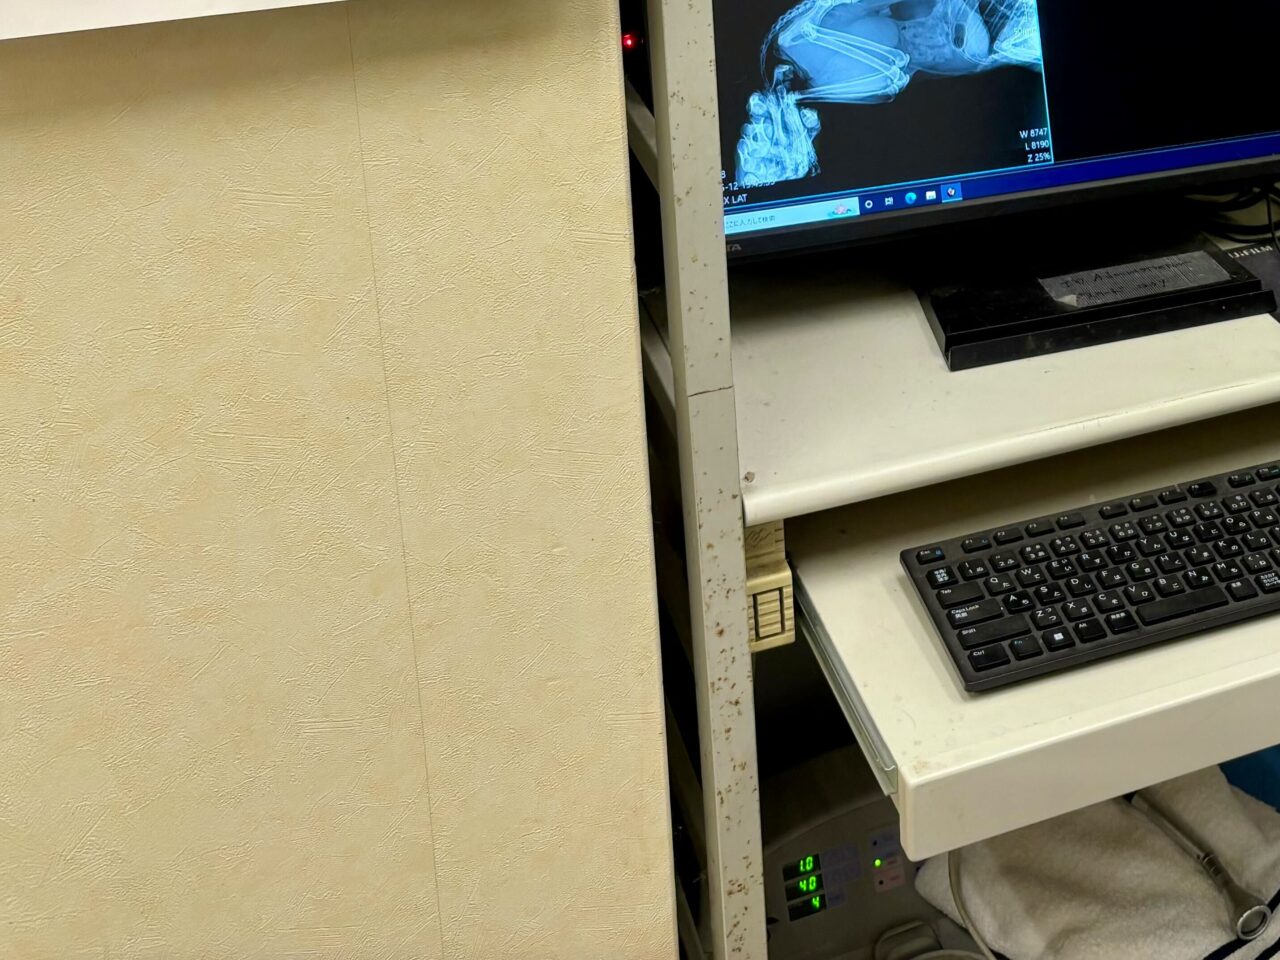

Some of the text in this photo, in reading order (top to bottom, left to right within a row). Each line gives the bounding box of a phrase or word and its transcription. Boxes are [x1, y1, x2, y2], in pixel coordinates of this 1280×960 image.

[1019, 127, 1048, 139] W 8747
[1025, 140, 1050, 151] L 8190
[1027, 153, 1034, 163] Z
[732, 193, 748, 204] LAT
[799, 876, 817, 892] 40
[812, 895, 820, 908] 4
